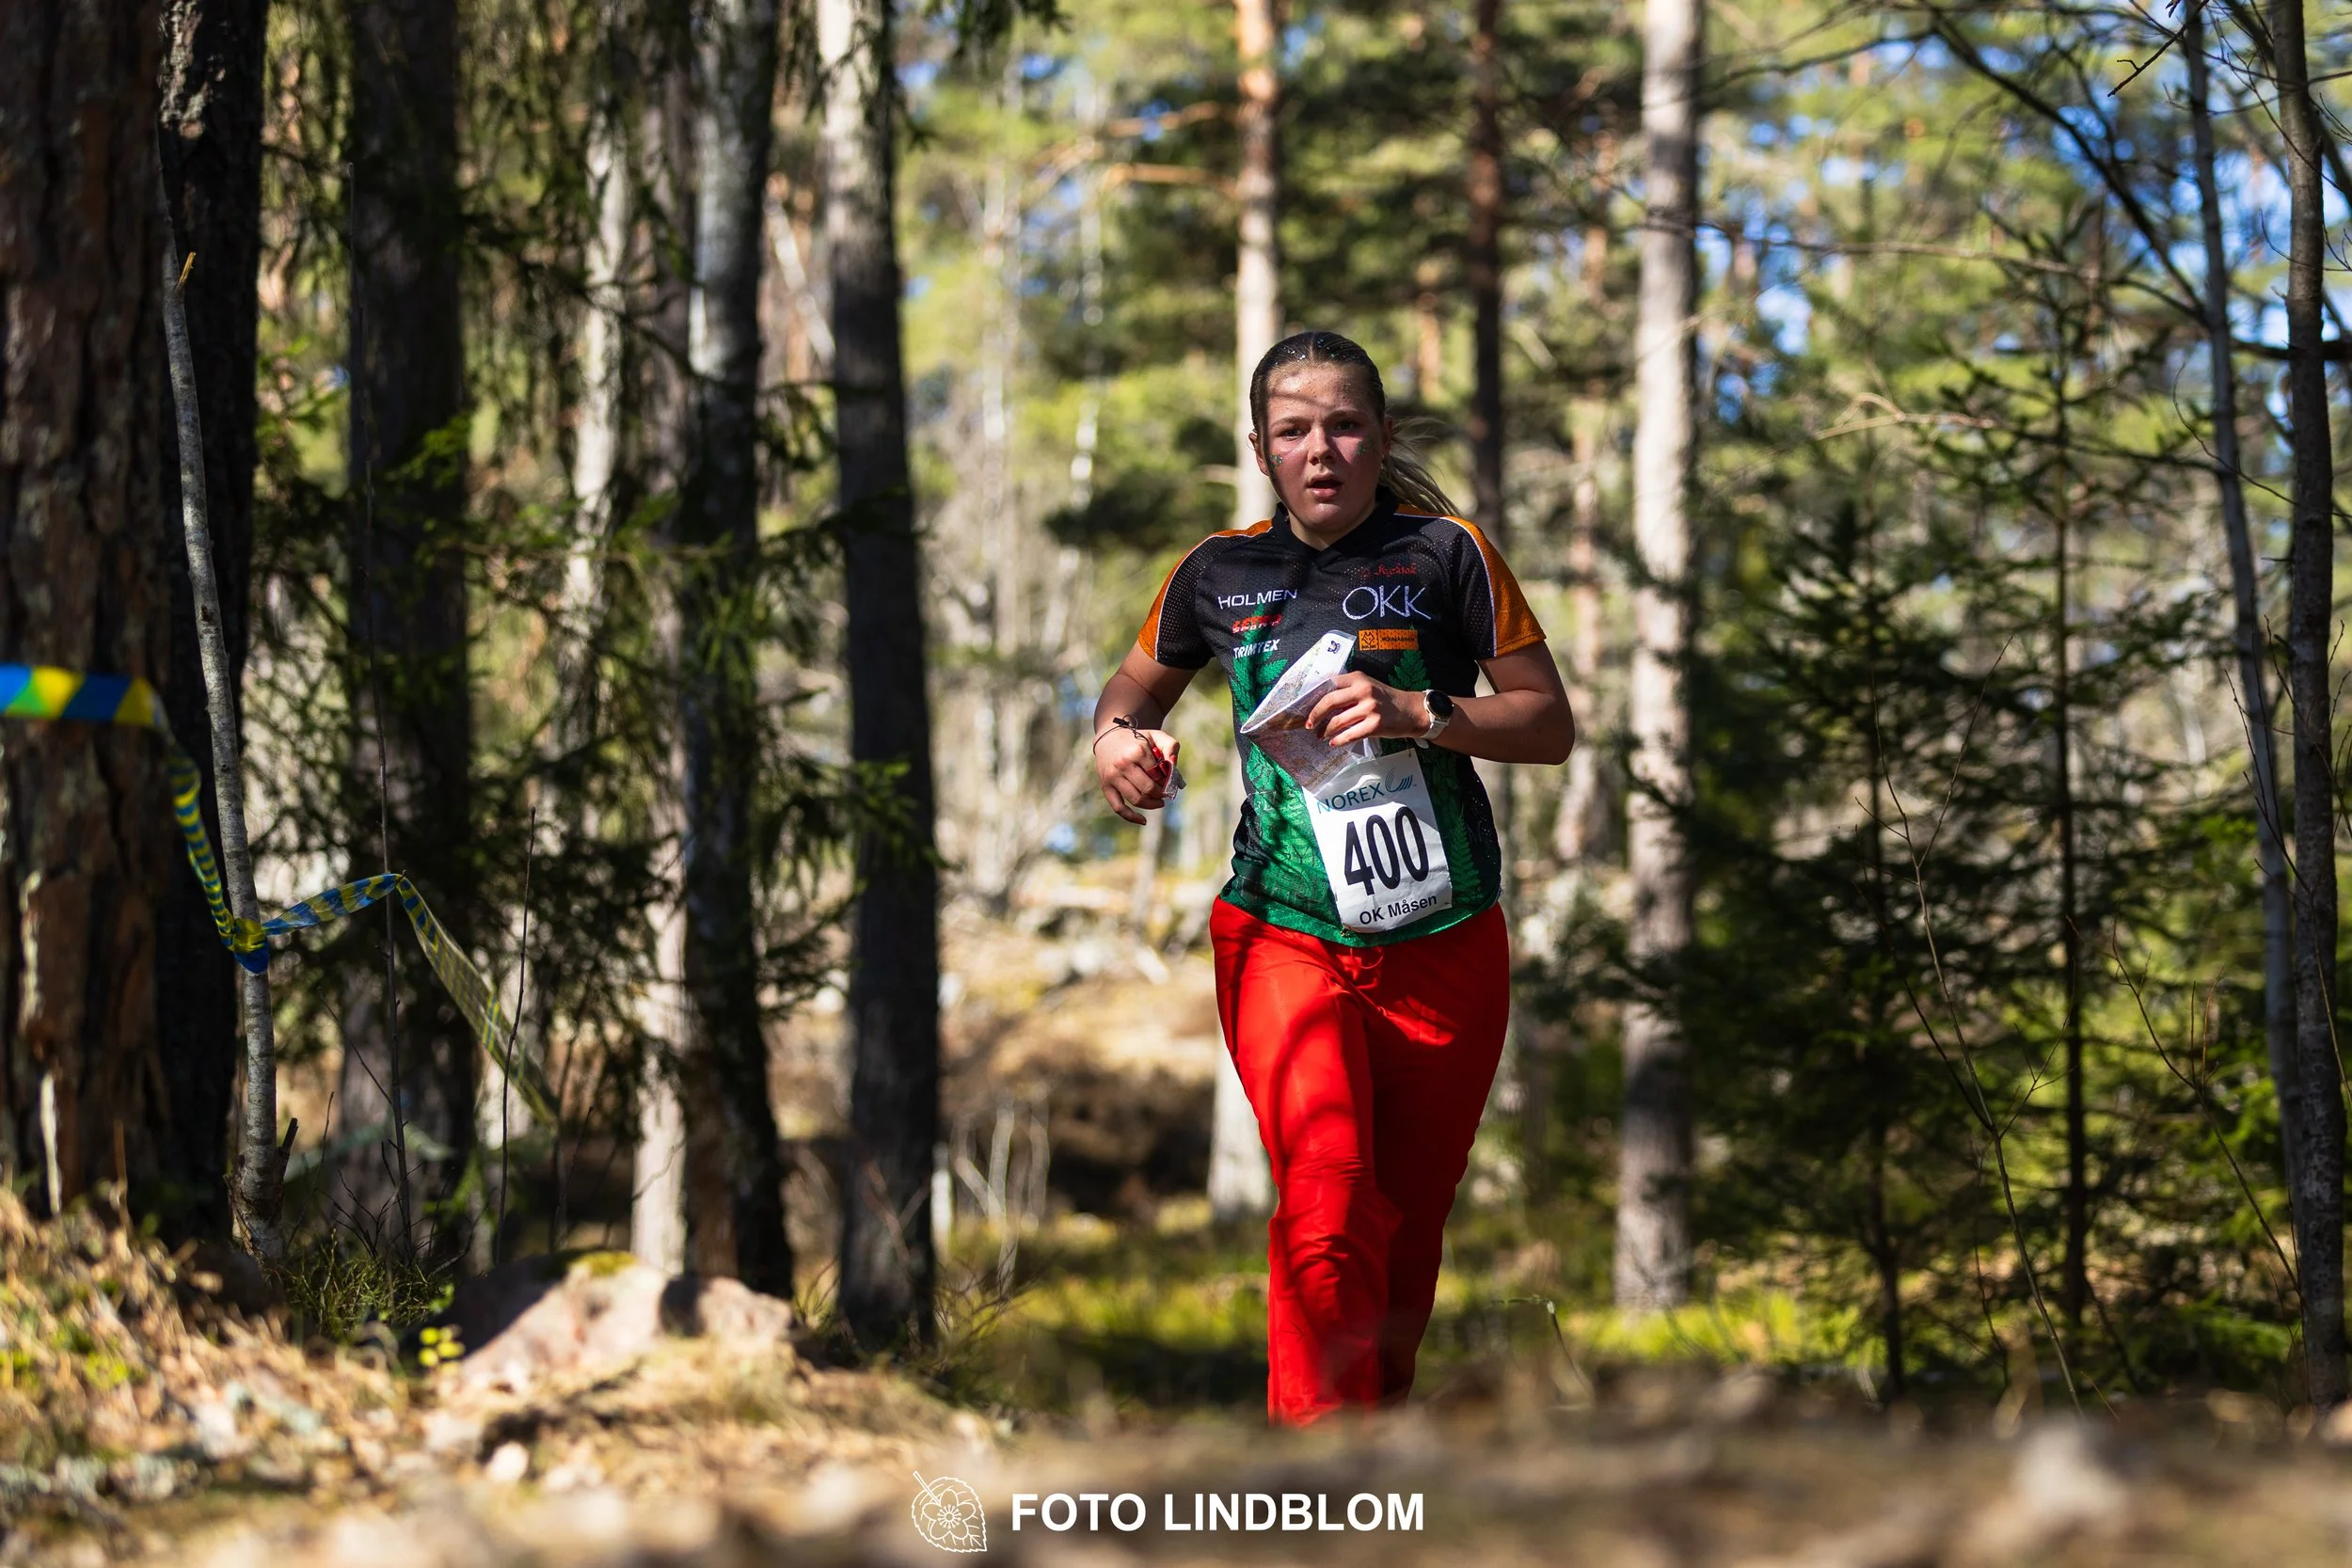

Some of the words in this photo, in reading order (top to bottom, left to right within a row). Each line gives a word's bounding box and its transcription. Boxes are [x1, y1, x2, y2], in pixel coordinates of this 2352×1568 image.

[1217, 589, 1297, 610] HOLMEN
[1342, 585, 1432, 621] OKK
[1232, 639, 1280, 659] TRIMTEX
[1317, 782, 1385, 815] NOREX
[1343, 806, 1430, 896] 400
[1359, 907, 1385, 925] OK
[1388, 895, 1438, 918] Måsen
